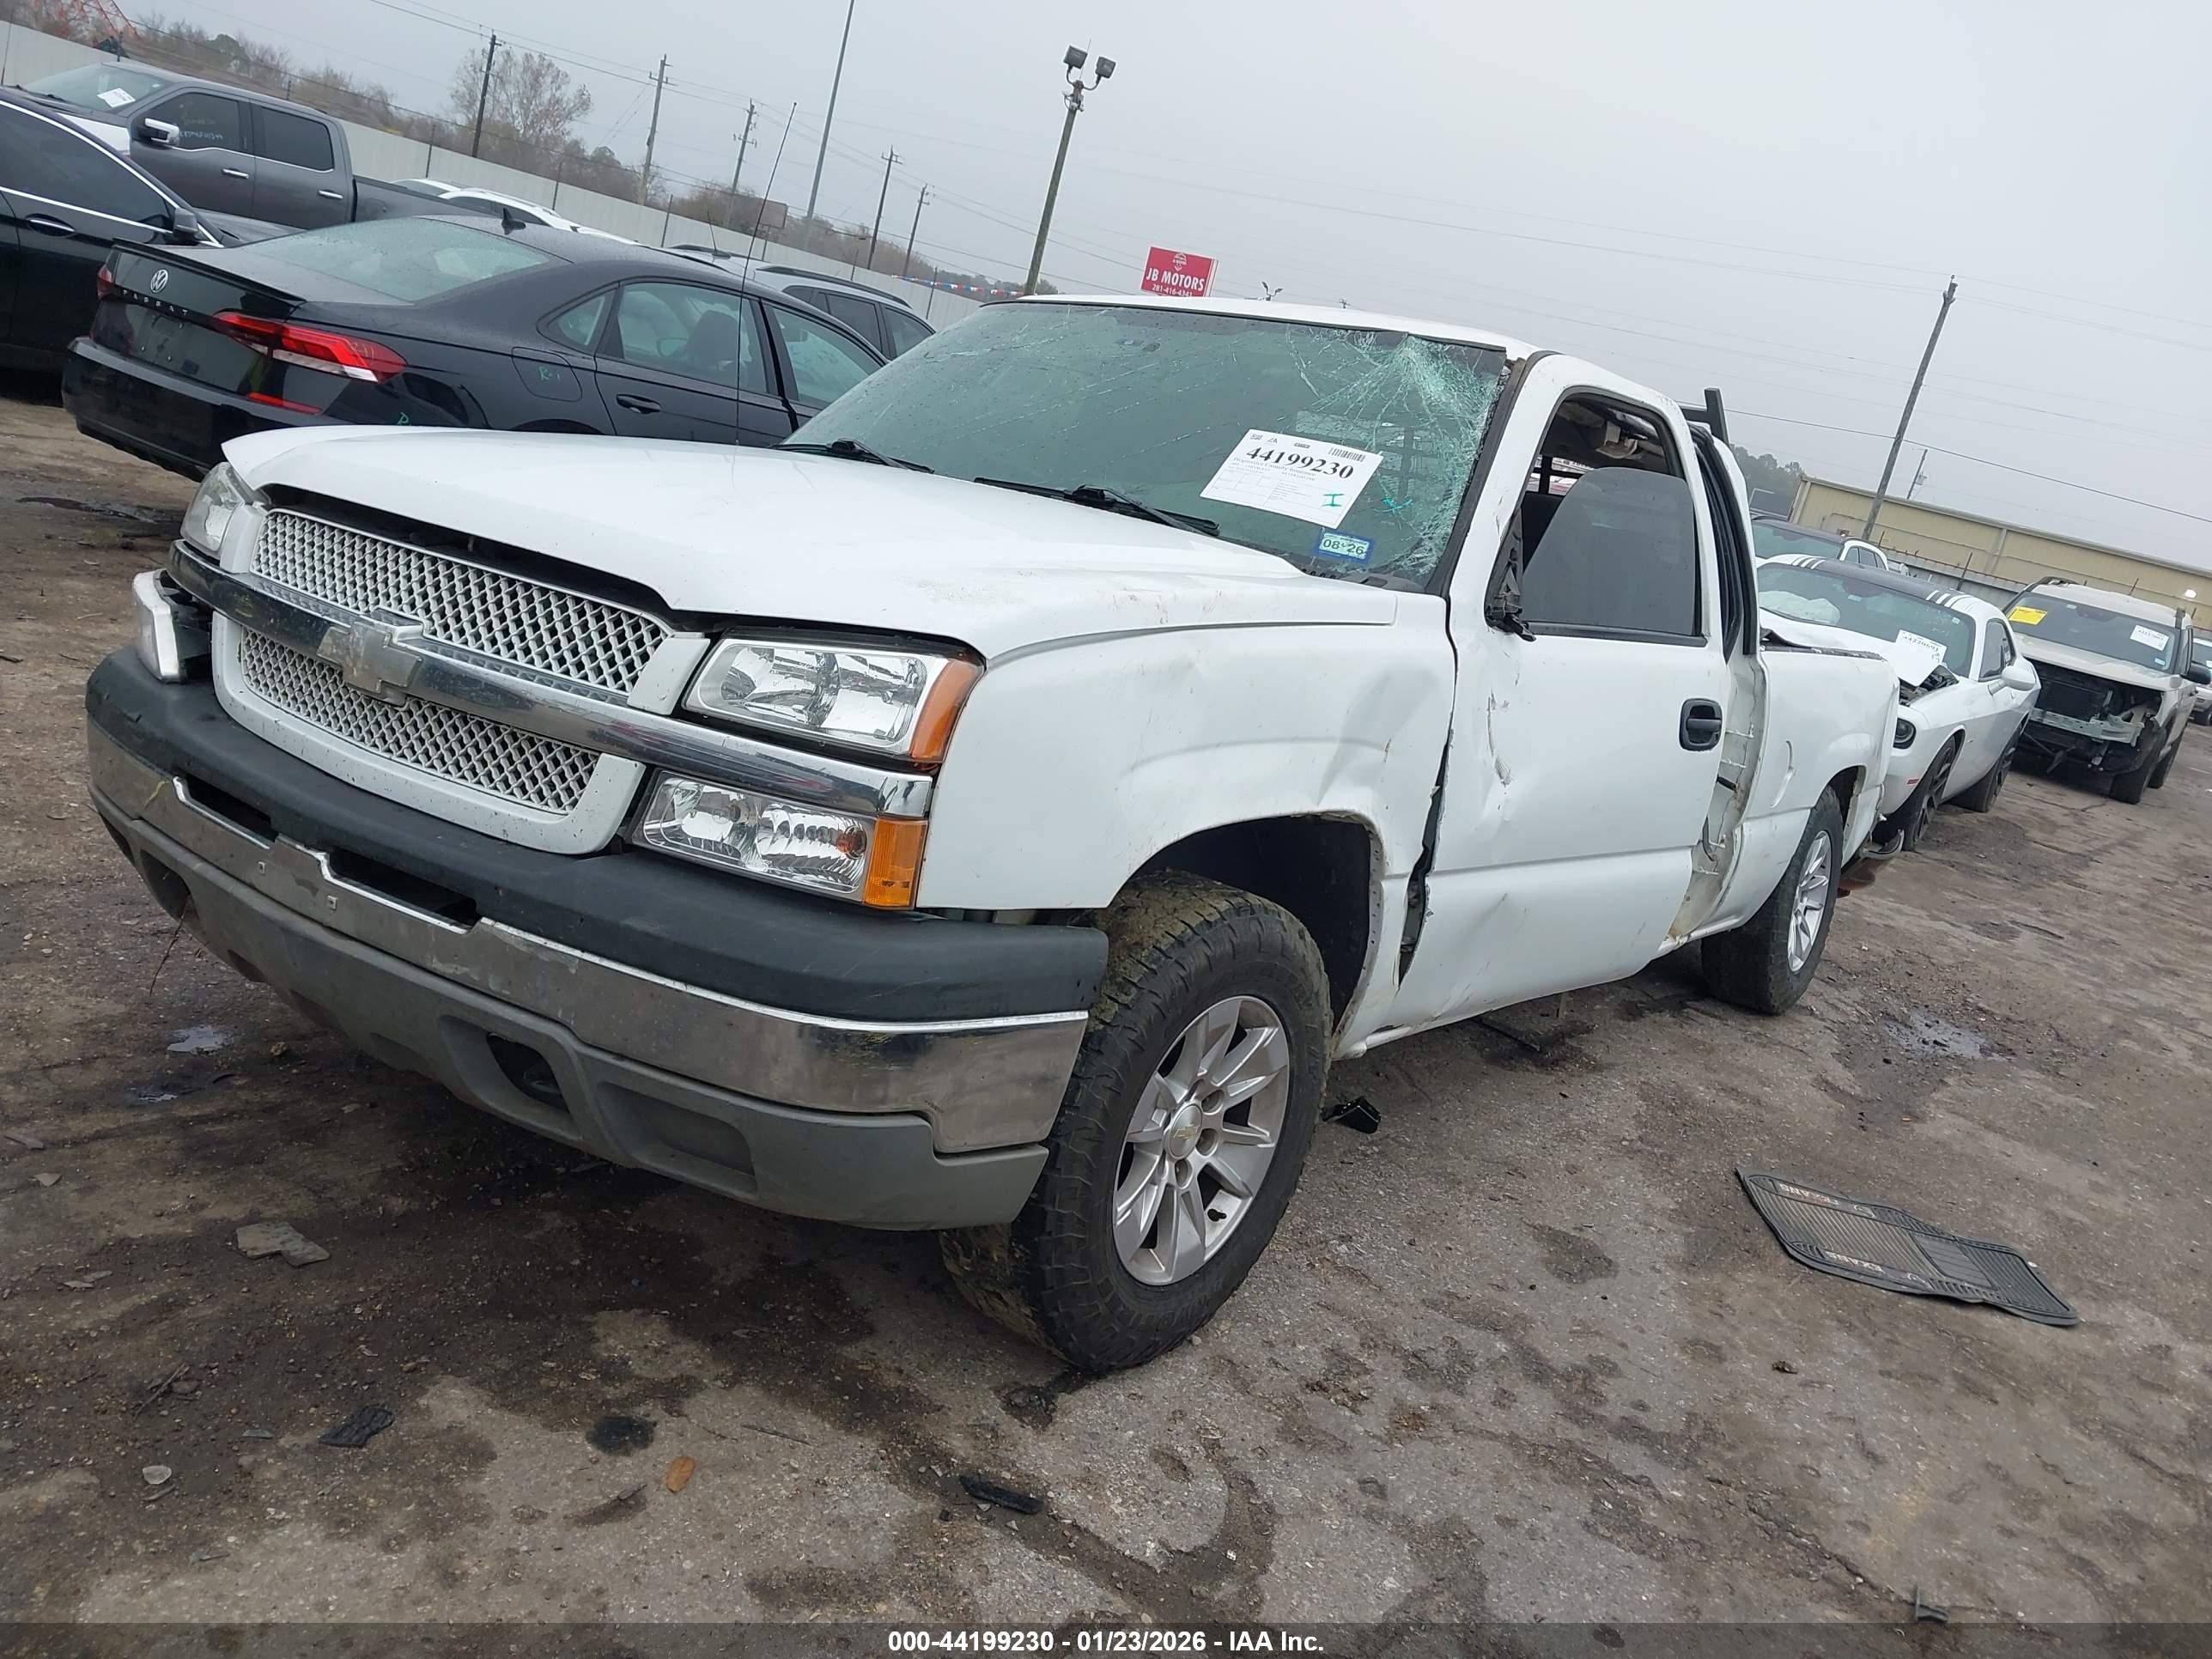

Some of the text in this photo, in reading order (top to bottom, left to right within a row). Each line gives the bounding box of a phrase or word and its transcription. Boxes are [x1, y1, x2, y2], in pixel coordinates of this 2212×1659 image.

[1146, 267, 1205, 291] JB MOTORS
[1247, 447, 1354, 478] 44199230
